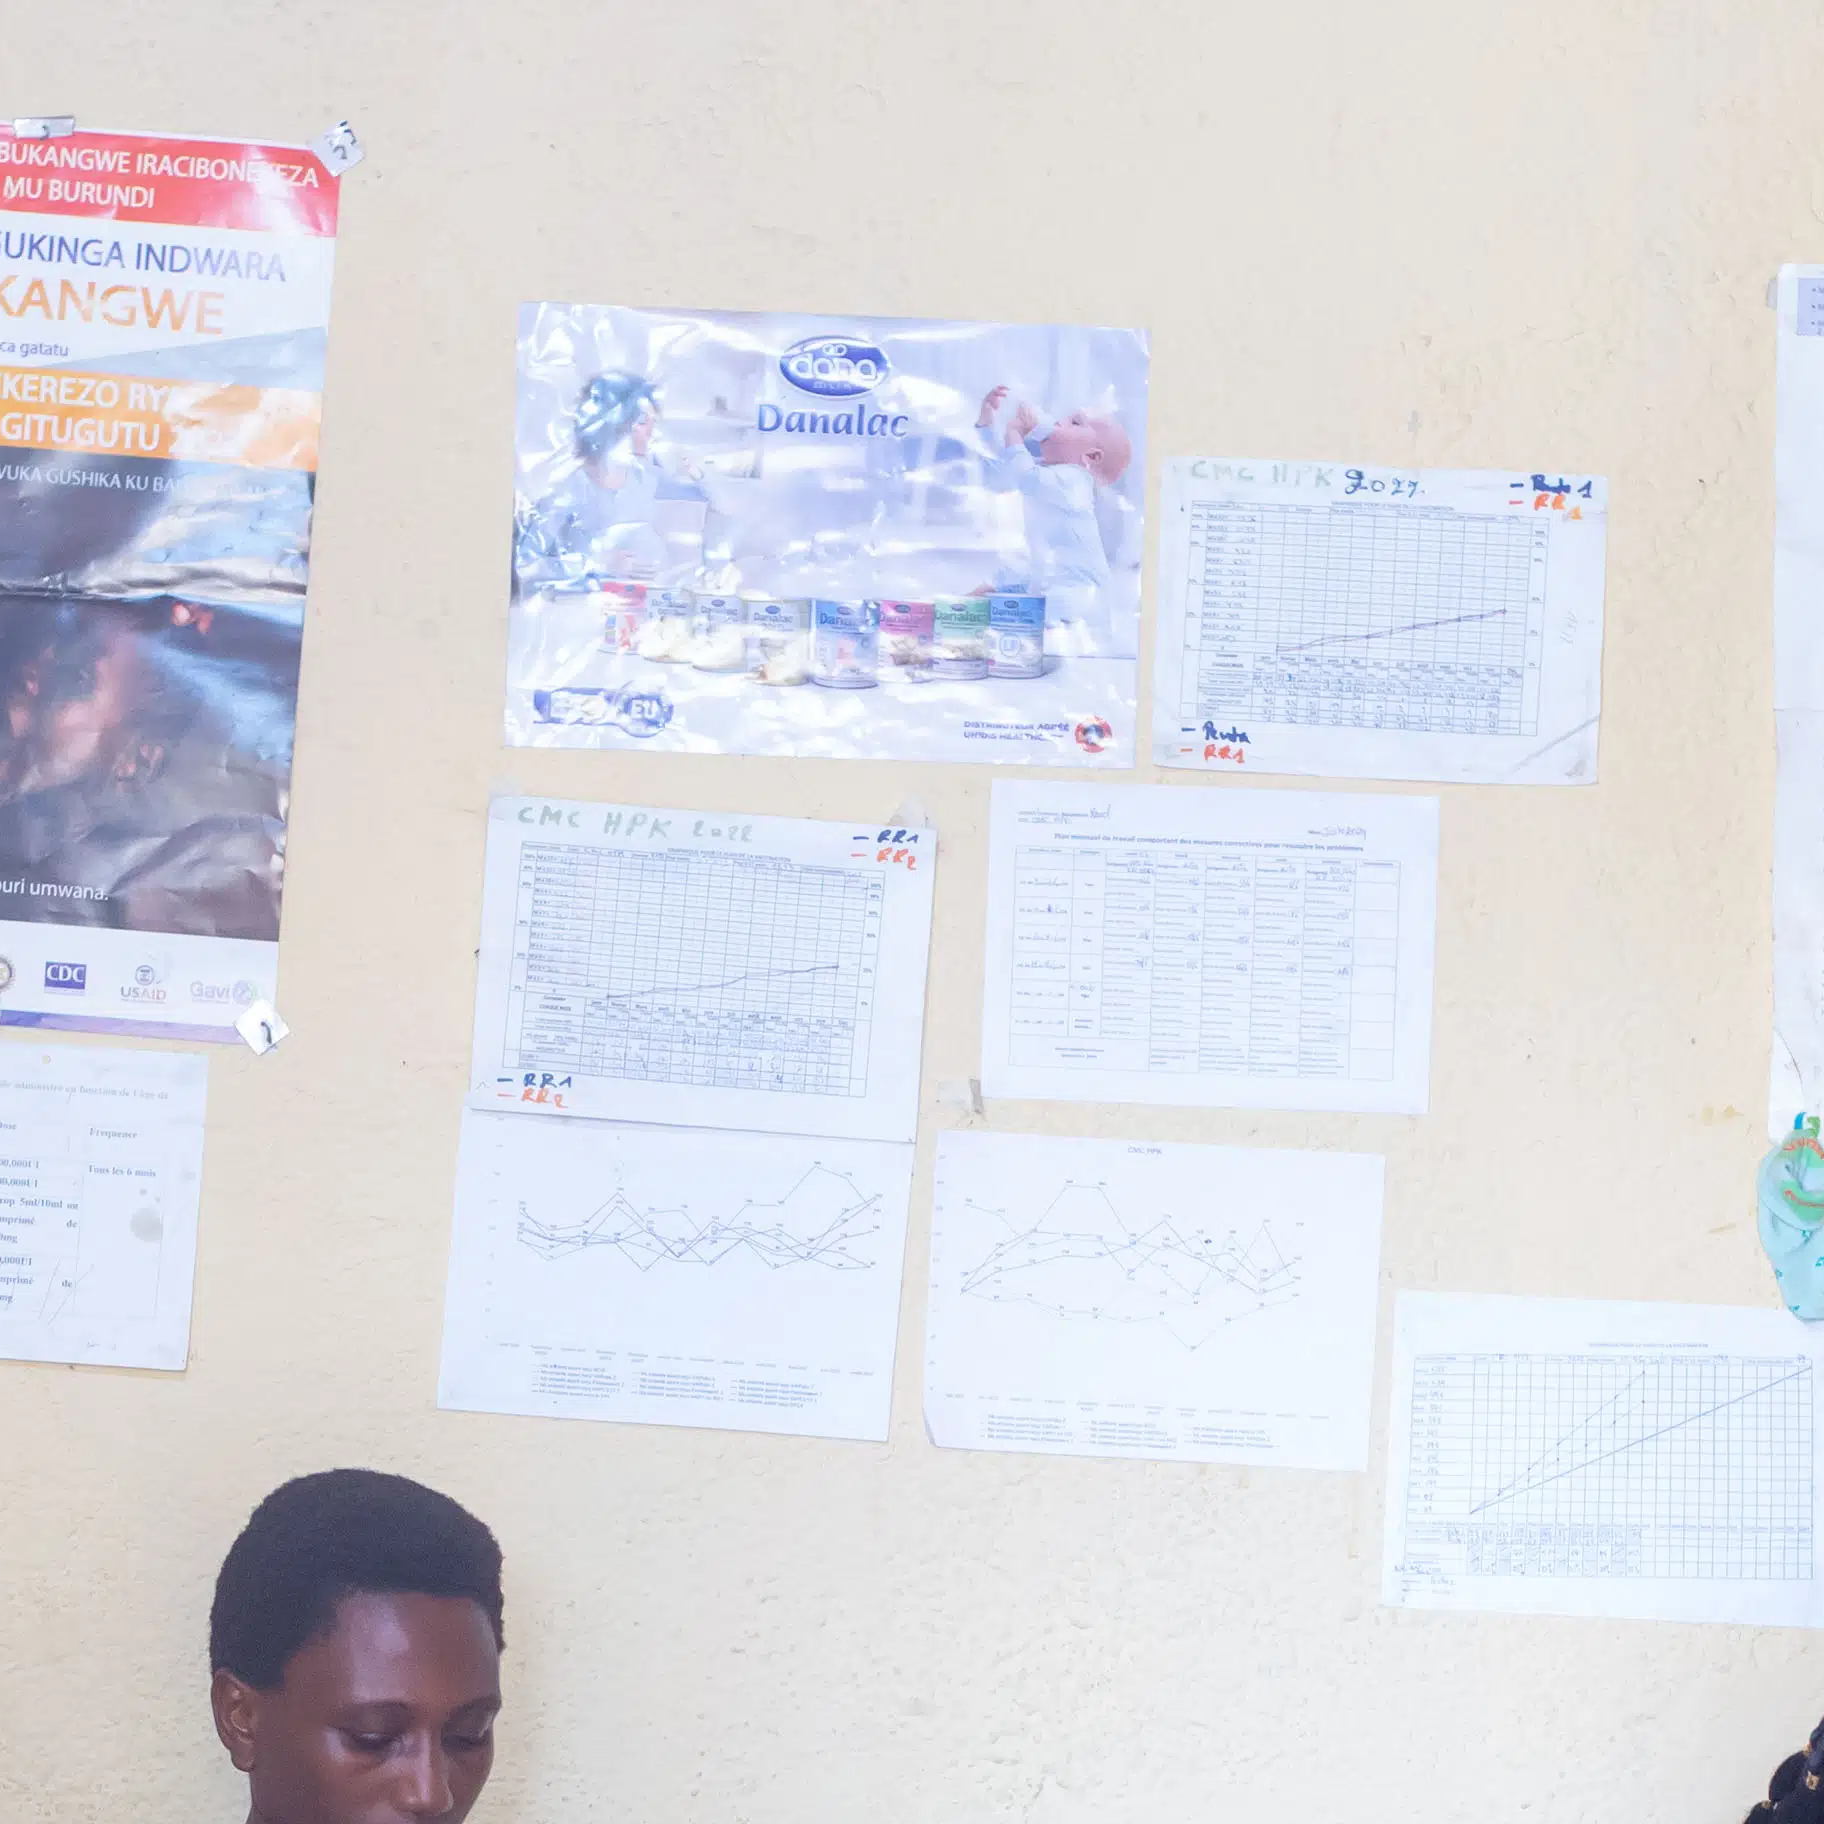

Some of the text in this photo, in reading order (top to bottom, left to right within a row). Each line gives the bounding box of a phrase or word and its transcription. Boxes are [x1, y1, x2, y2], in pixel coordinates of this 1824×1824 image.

[135, 152, 320, 189] IRACIBONEEZA
[2, 175, 155, 209] MU BURUNDI
[136, 243, 287, 282] INDWARA
[757, 403, 909, 438] Danalac
[45, 468, 121, 489] GUSHIKA
[125, 472, 148, 490] KU
[517, 803, 581, 829] CMC
[603, 811, 673, 839] HPK
[29, 881, 109, 901] umwana.
[45, 963, 85, 984] CDC
[120, 985, 166, 1001] USAID
